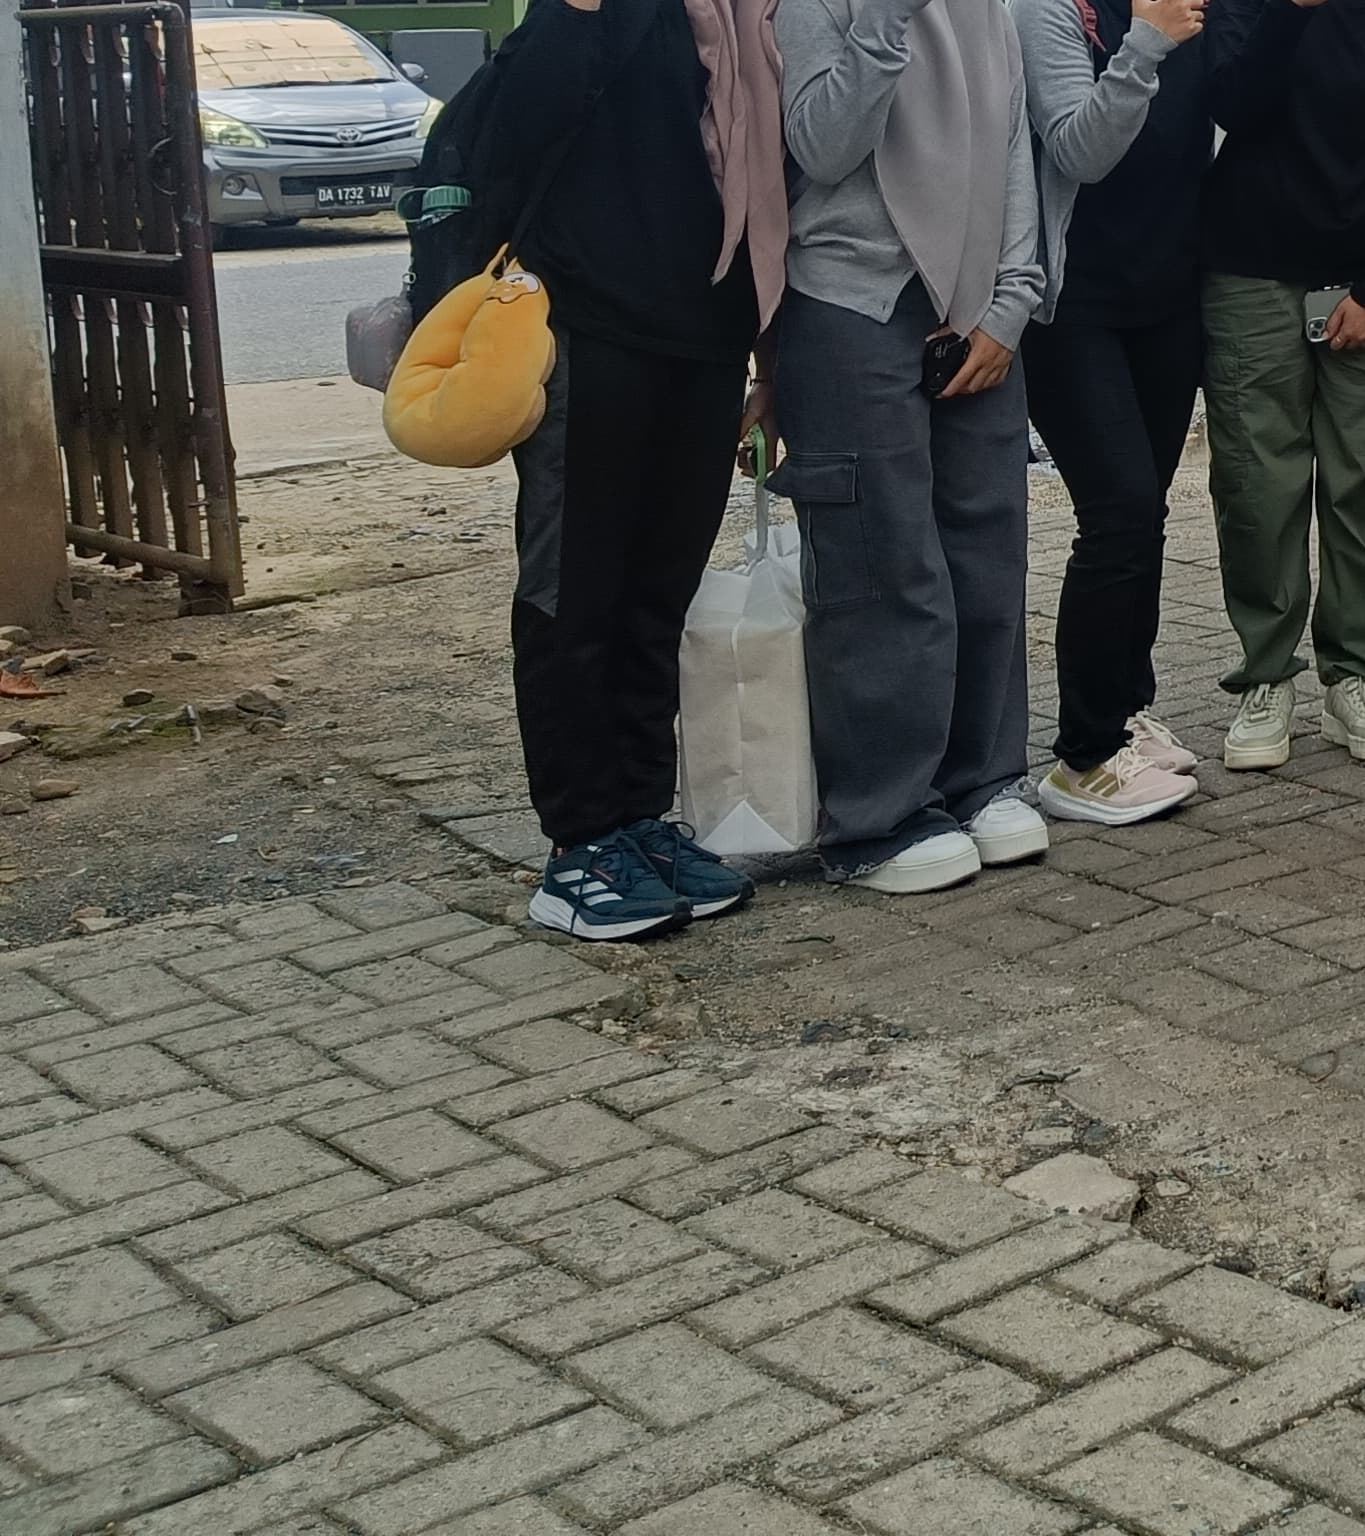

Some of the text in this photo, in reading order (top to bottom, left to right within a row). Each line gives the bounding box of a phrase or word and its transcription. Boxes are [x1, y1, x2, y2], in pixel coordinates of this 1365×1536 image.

[318, 185, 391, 202] DA 1732 TAV
